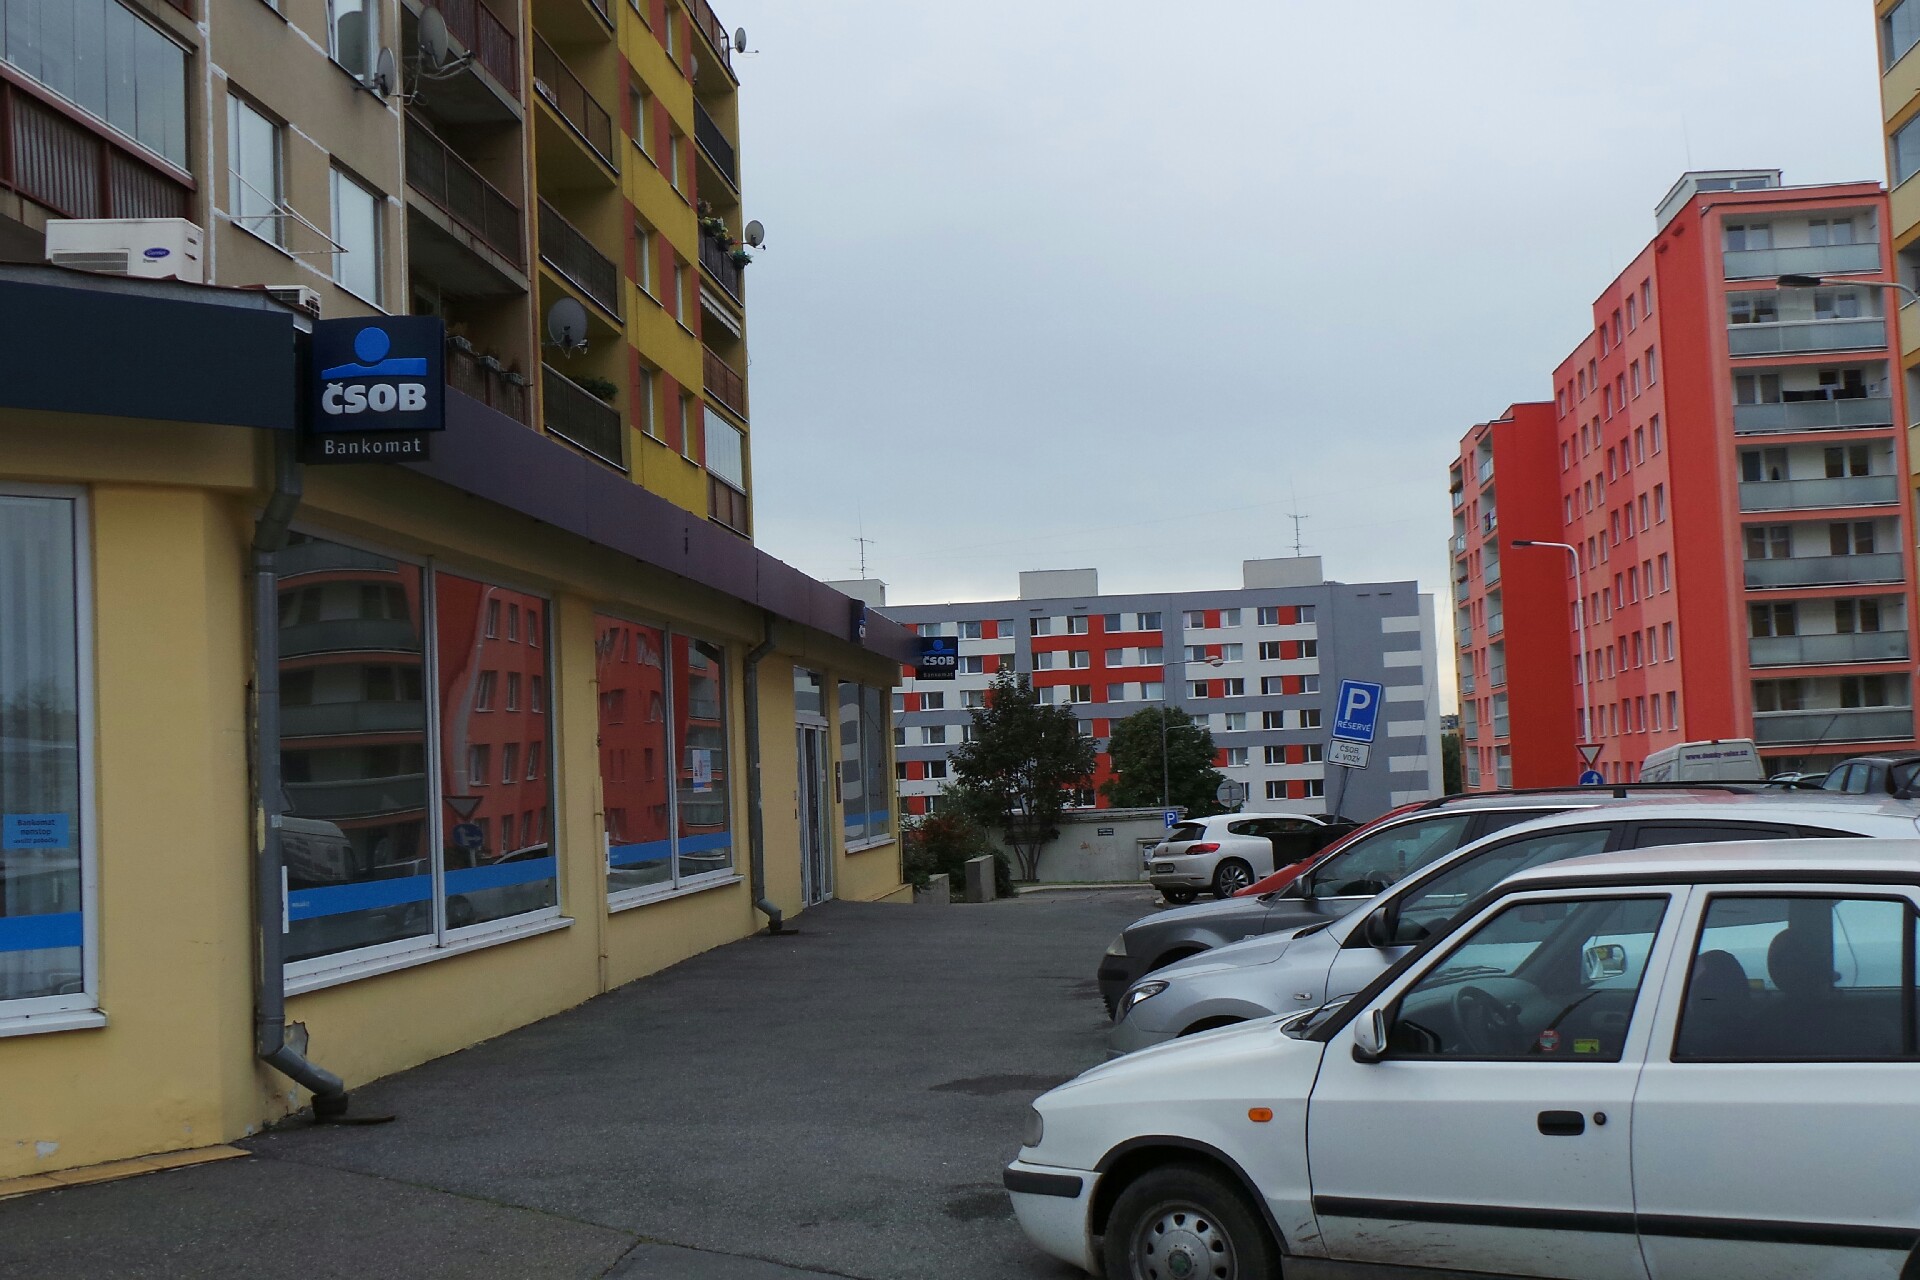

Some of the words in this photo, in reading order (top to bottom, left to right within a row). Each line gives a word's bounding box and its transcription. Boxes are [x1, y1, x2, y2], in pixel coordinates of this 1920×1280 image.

[322, 382, 427, 415] ČSOB
[325, 438, 421, 454] Bankomat
[923, 656, 955, 666] ČSOB
[1344, 687, 1371, 720] P
[1167, 813, 1175, 824] P
